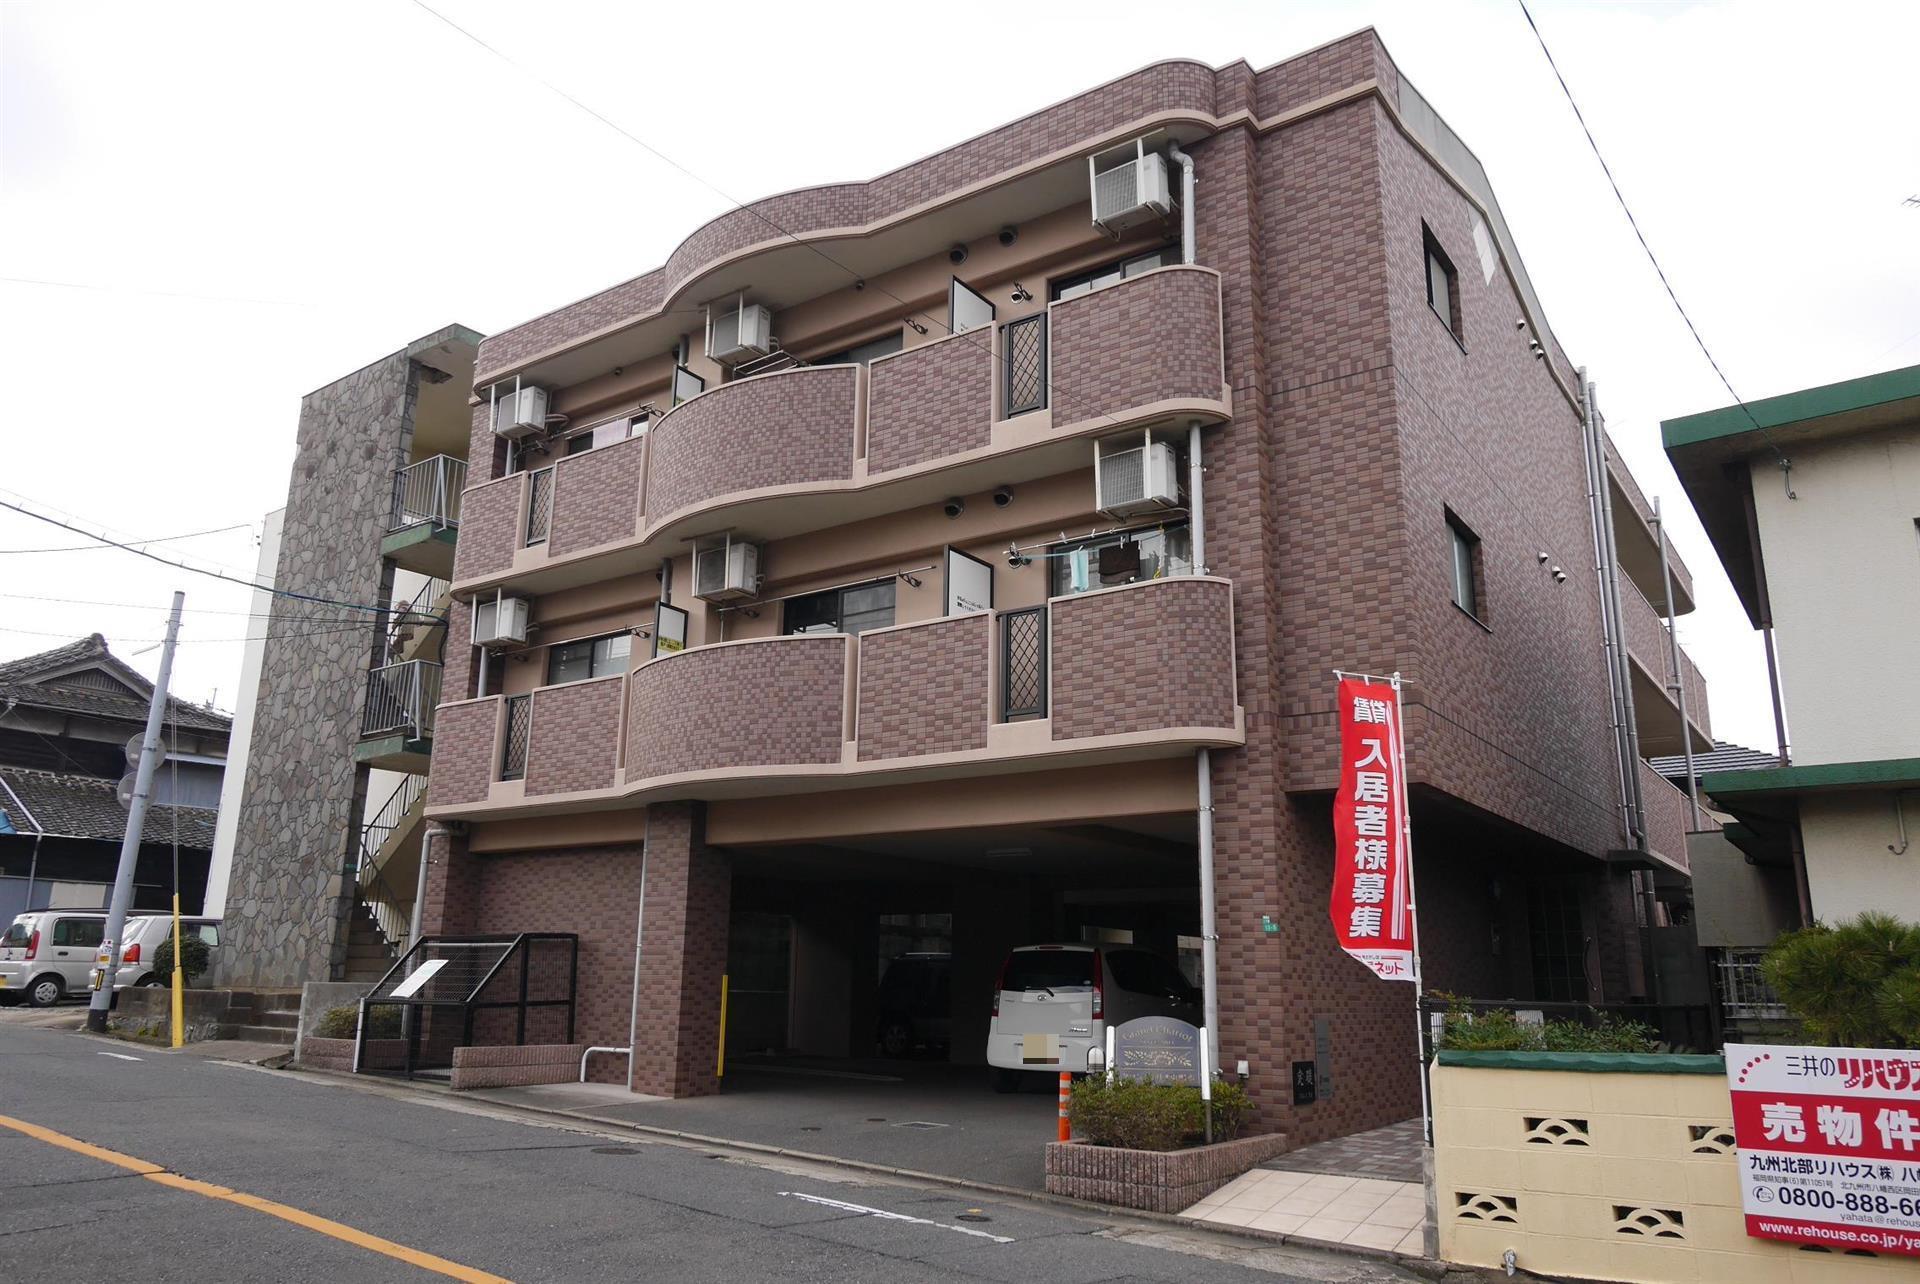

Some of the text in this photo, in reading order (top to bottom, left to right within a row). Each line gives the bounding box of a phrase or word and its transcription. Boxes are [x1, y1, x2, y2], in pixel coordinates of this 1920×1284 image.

[1349, 738, 1389, 938] 入居者様募集
[1760, 1102, 1920, 1151] 売物件
[1840, 1181, 1920, 1196] 北九州市八幡西区岡田
